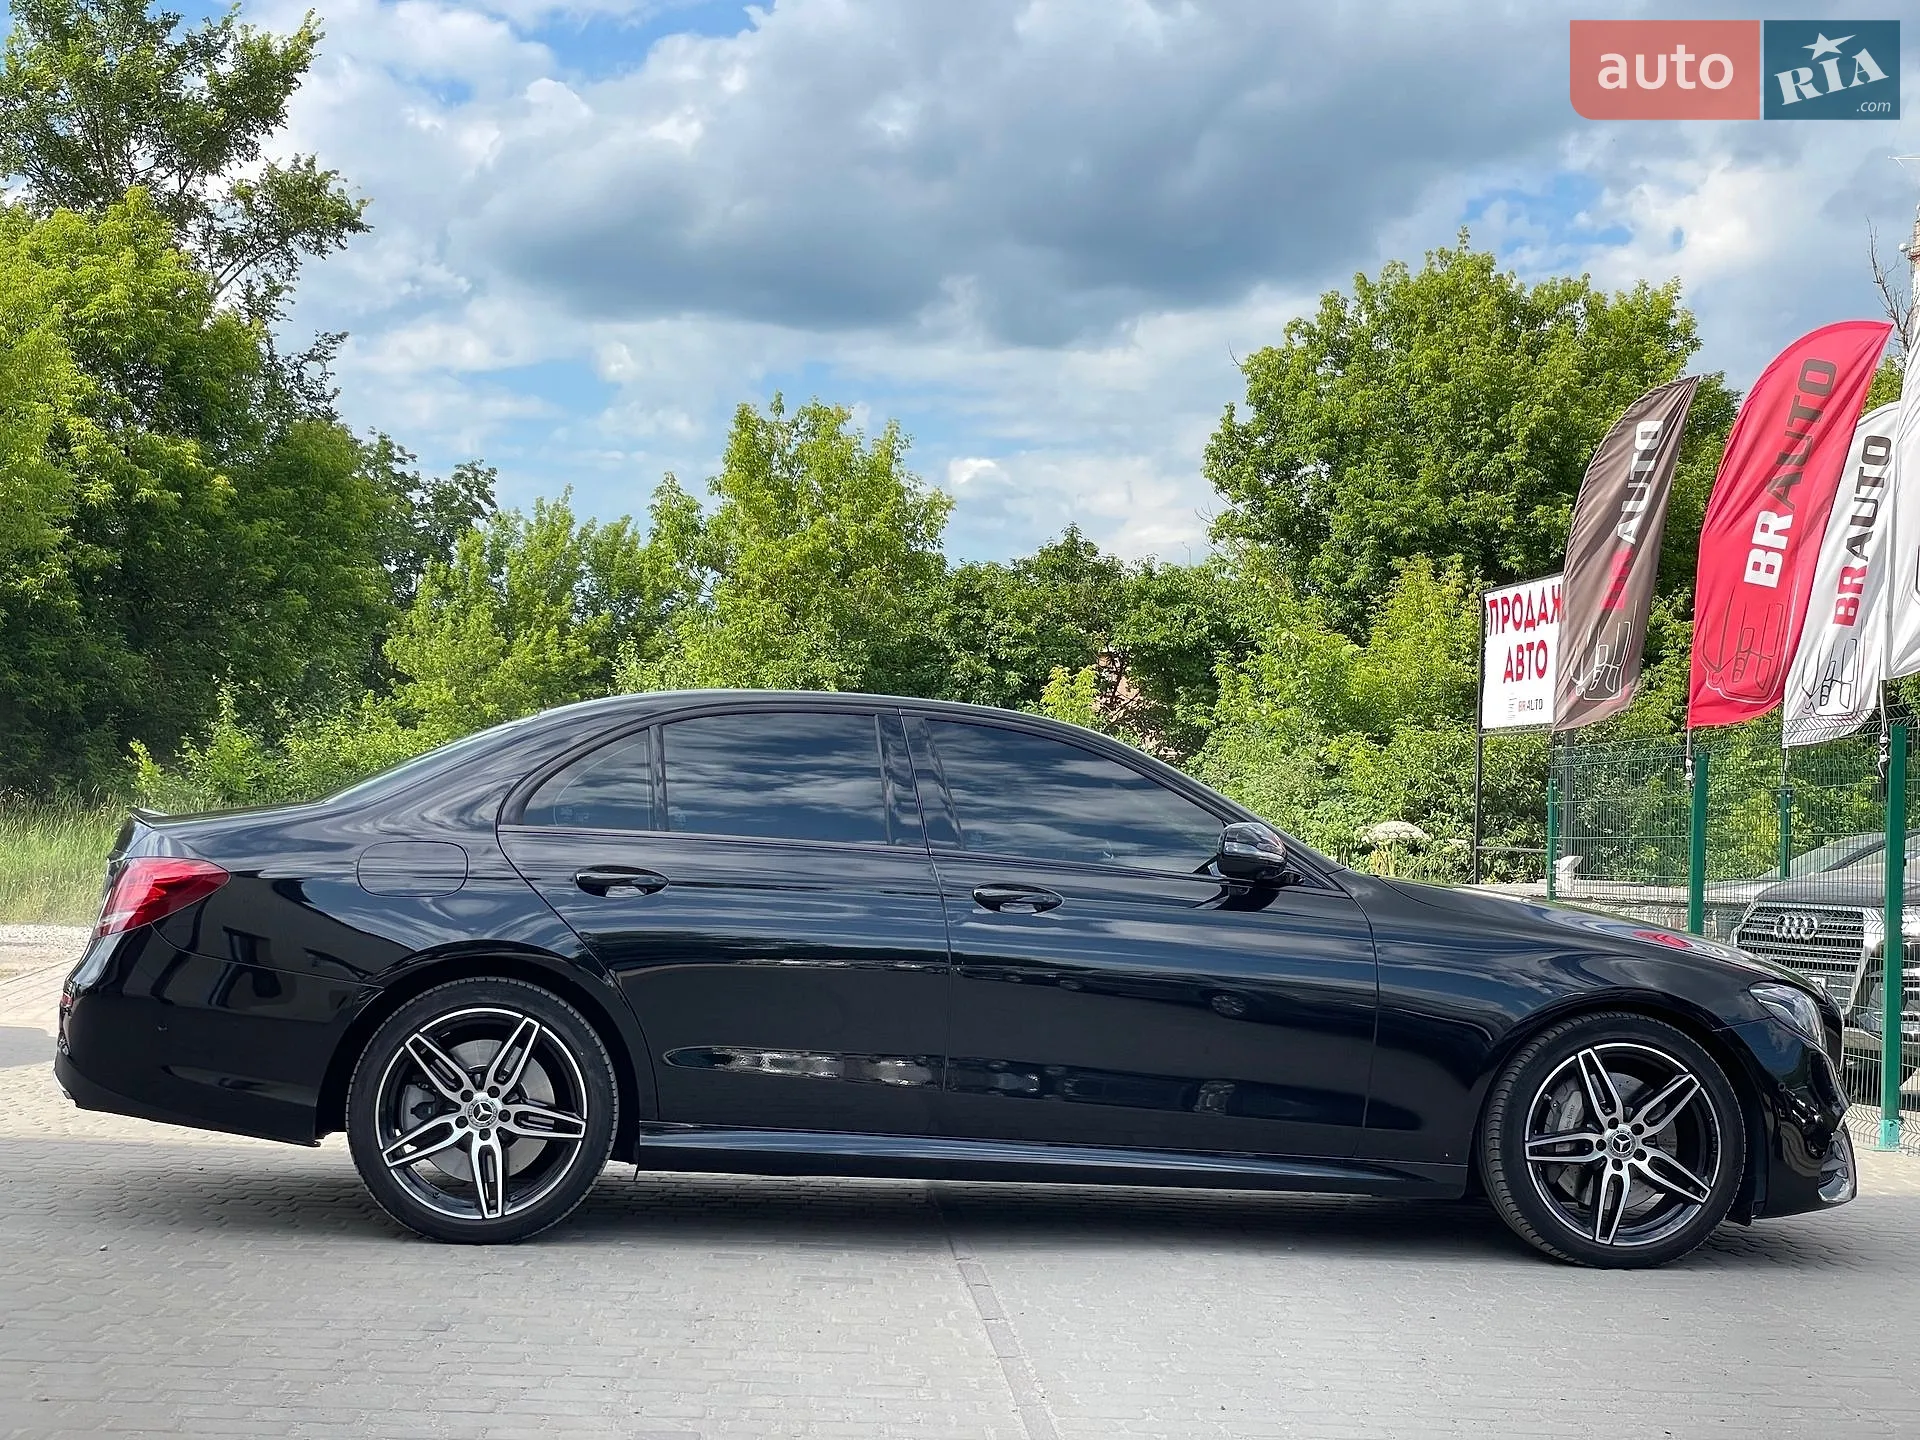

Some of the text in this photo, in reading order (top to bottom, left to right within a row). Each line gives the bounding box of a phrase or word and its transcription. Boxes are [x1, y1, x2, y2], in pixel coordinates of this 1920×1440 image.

[1743, 358, 1838, 588] BRAUTO
[1832, 435, 1893, 627] BRAUTO
[1503, 639, 1548, 684] АВТО
